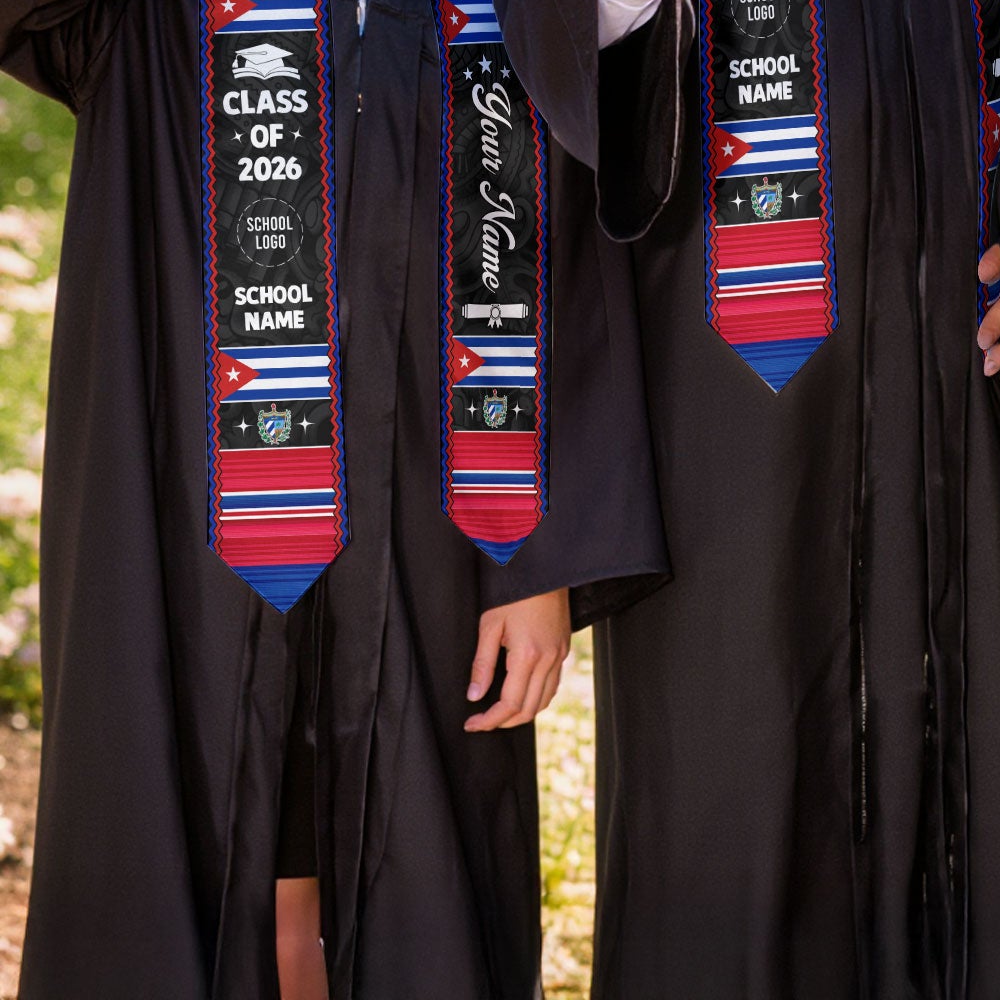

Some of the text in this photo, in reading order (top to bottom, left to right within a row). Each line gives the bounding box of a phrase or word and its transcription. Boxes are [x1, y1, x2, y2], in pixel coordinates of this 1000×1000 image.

[747, 3, 776, 21] LOGO
[729, 53, 800, 79] SCHOOL
[222, 88, 309, 116] CLASS
[738, 80, 793, 105] NAME
[250, 123, 284, 149] OF
[237, 155, 303, 182] 2026
[472, 82, 516, 294] Your Name
[246, 215, 294, 233] SCHOOL
[255, 233, 287, 251] LOGO
[234, 283, 313, 306] SCHOOL
[244, 310, 305, 332] NAME
